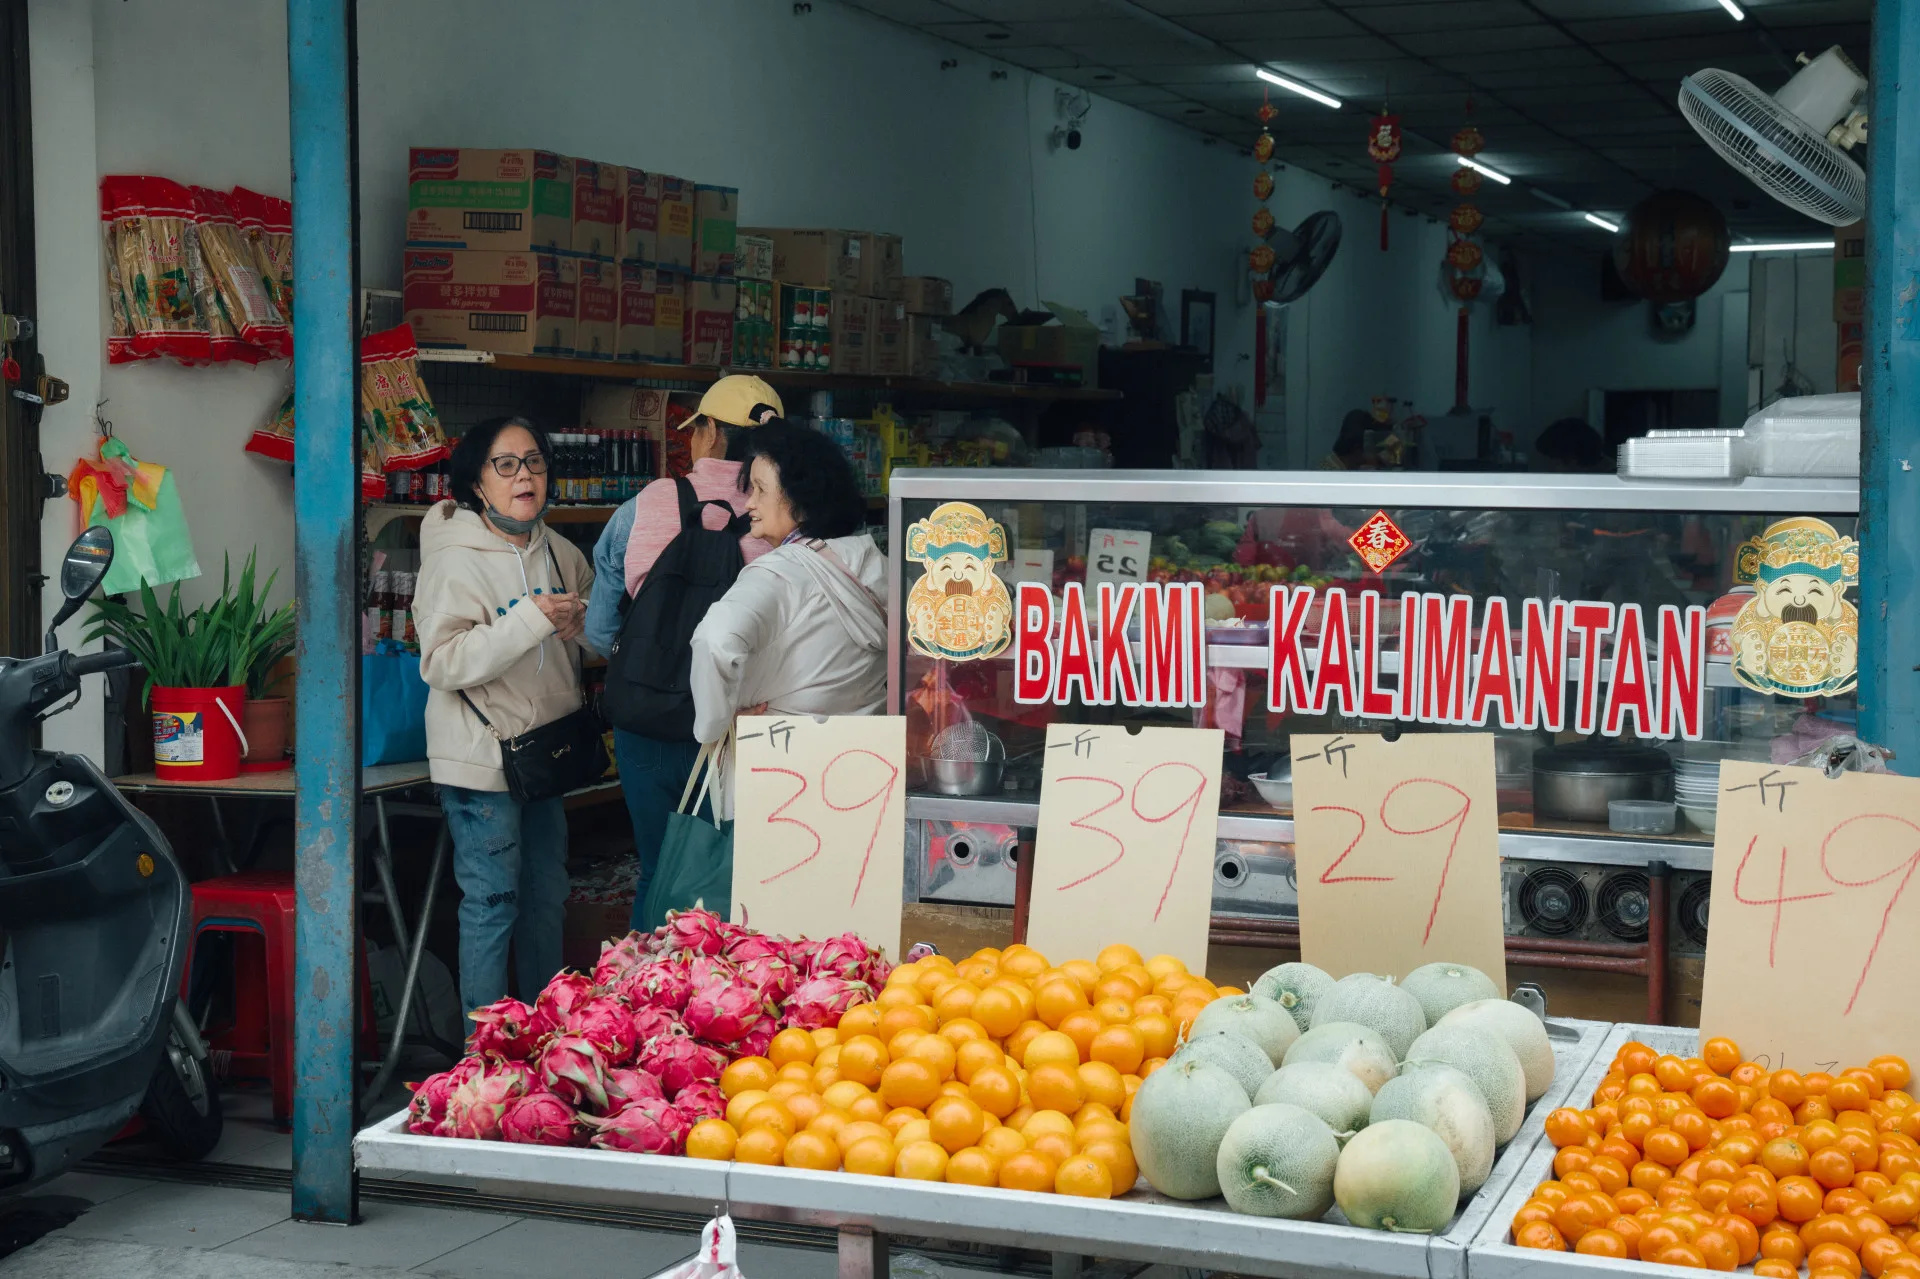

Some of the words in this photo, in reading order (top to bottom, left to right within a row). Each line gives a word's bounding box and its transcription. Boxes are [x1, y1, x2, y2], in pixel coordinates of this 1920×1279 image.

[1366, 520, 1395, 549] 春
[1015, 582, 1206, 708] BAKMI
[1268, 584, 1706, 741] KALIMANTAN
[737, 720, 796, 754] 一斤
[1047, 728, 1100, 759] 一斤
[1295, 736, 1356, 779] 一斤
[750, 748, 898, 909] 39
[1725, 769, 1800, 812] 一斤
[1055, 762, 1207, 923] 39
[1310, 778, 1472, 947] 29
[1733, 813, 1920, 1016] 49
